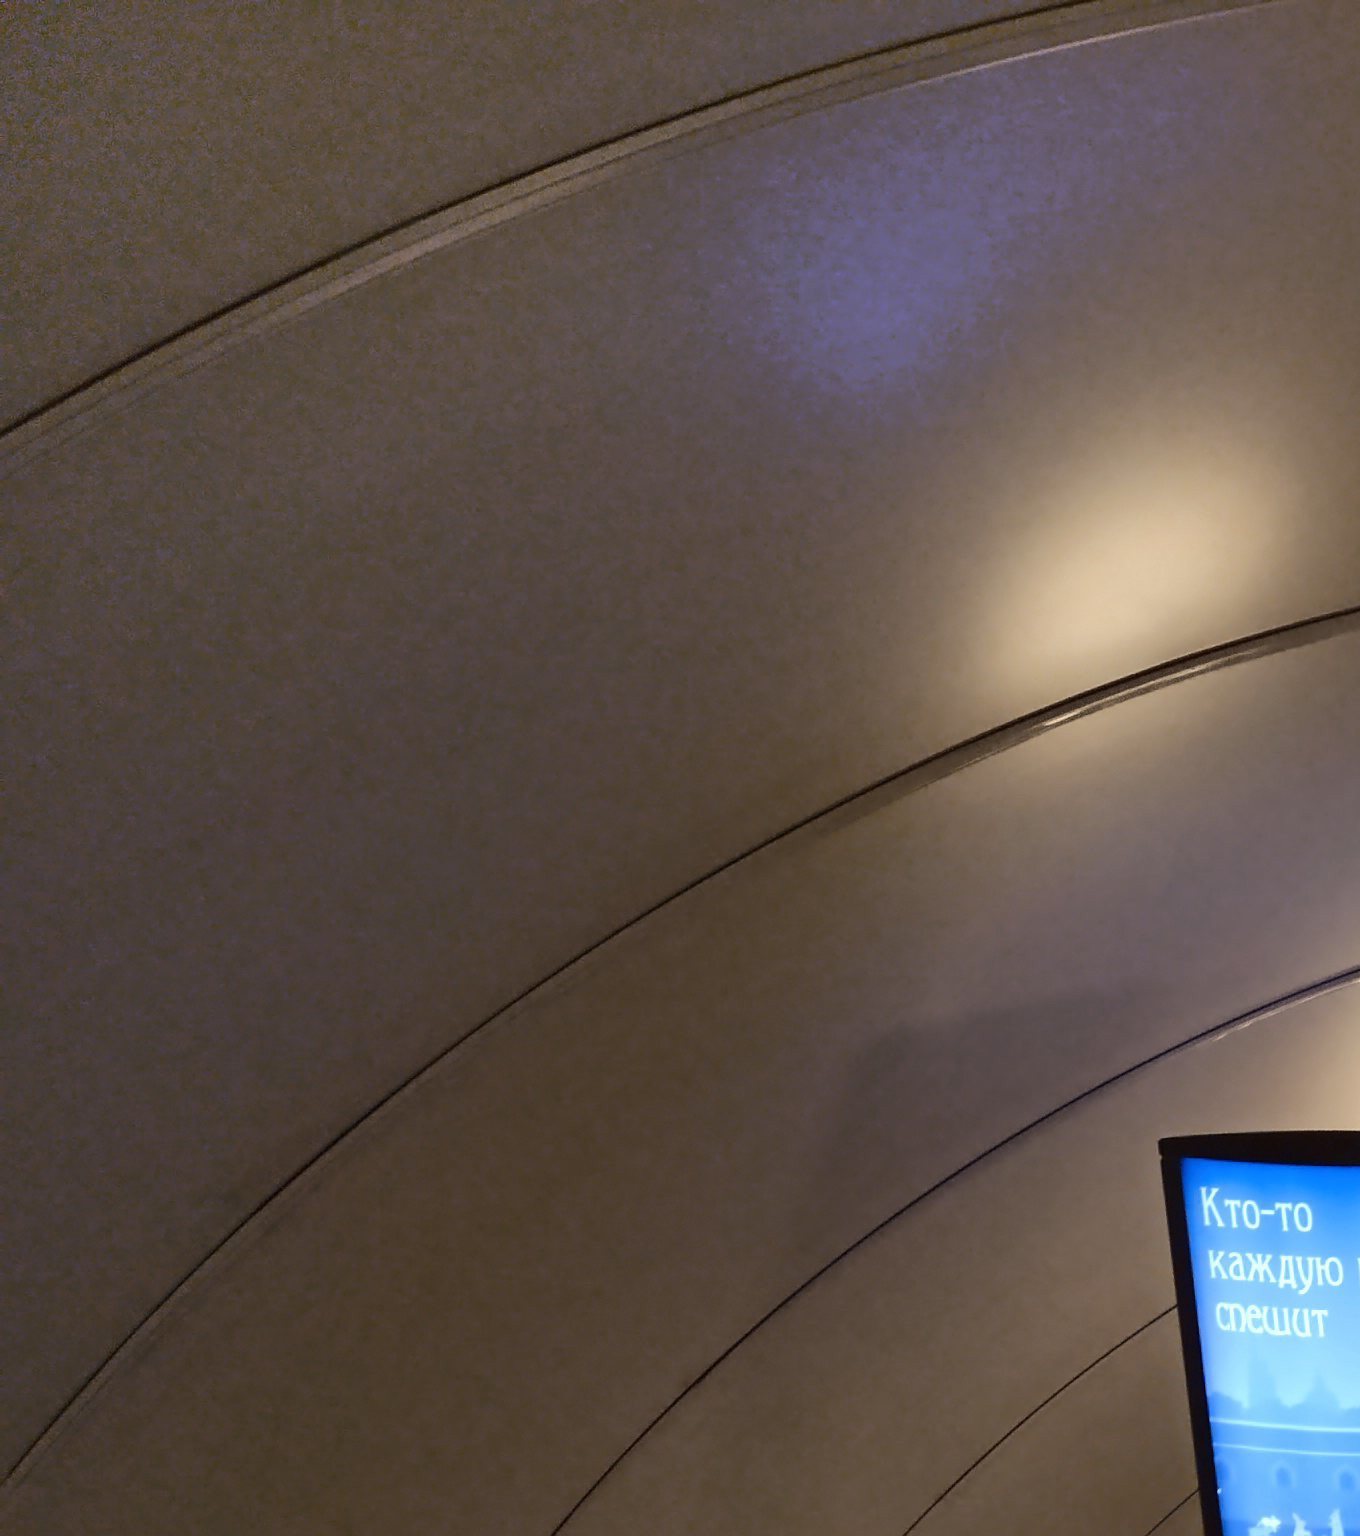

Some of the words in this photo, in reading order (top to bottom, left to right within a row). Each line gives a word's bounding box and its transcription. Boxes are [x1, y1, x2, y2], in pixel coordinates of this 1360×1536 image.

[1200, 1187, 1313, 1232] Кто-то
[1208, 1250, 1344, 1295] каждую
[1216, 1302, 1329, 1338] спешит
